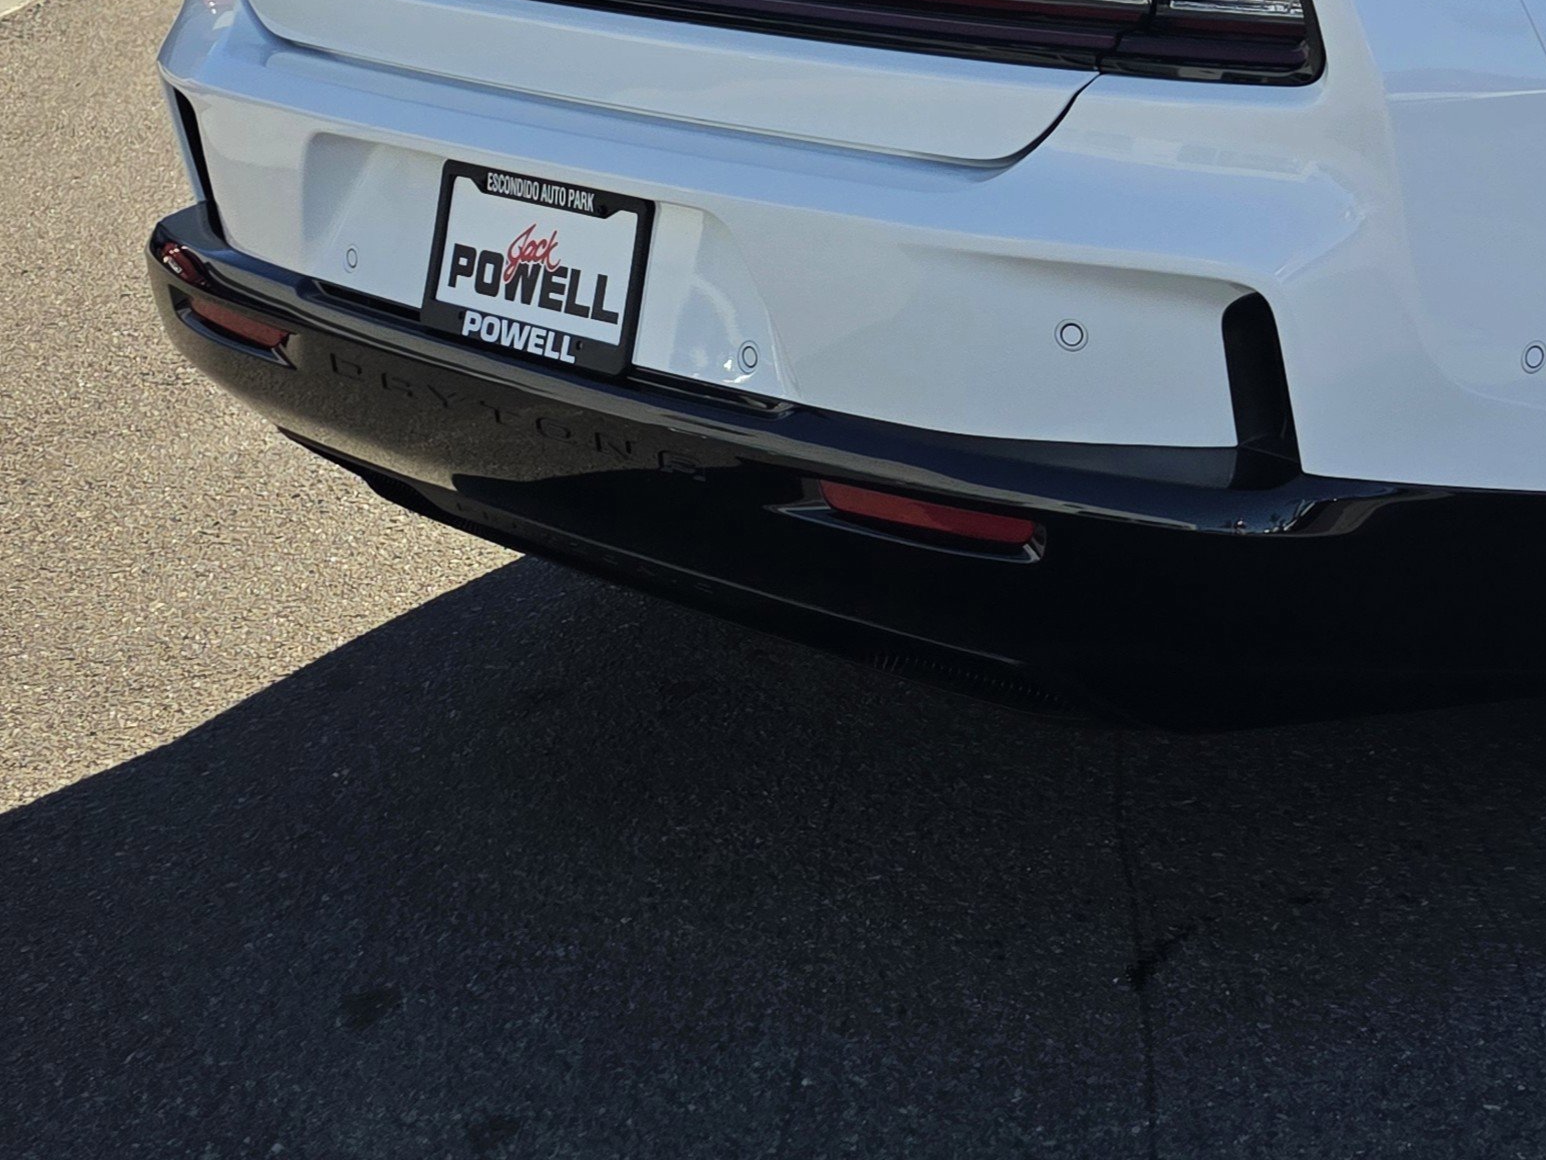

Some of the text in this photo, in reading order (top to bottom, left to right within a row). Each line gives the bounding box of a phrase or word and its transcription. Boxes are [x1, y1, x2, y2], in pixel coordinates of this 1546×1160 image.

[487, 172, 595, 212] ESCONDIDO AUTO PARK
[503, 223, 561, 283] Jack
[448, 243, 619, 325] POWELL
[461, 310, 576, 364] POWELL
